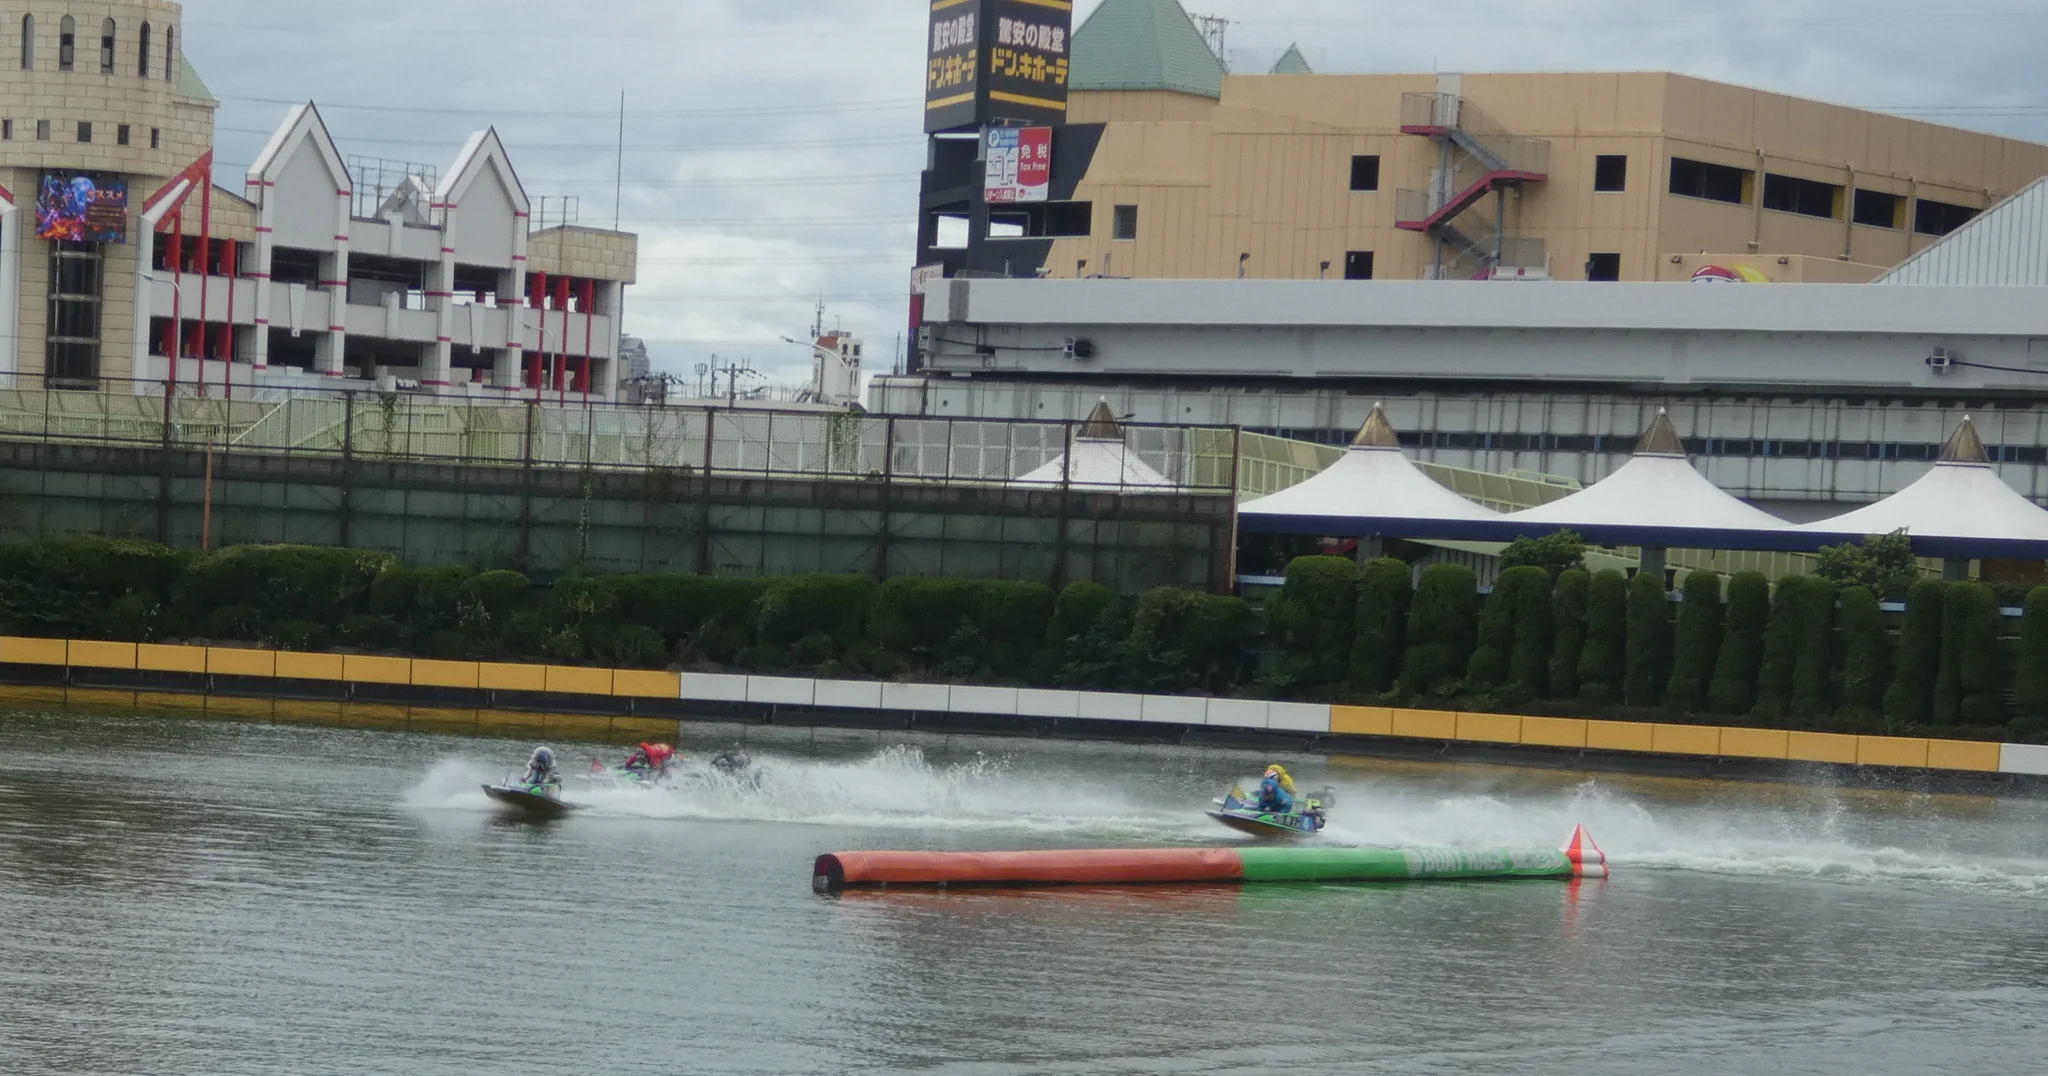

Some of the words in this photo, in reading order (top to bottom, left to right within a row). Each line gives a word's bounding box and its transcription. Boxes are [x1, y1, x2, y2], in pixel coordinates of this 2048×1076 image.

[999, 17, 1065, 53] 驚安の殿堂
[1020, 162, 1031, 171] Tax
[1032, 161, 1047, 172] Free
